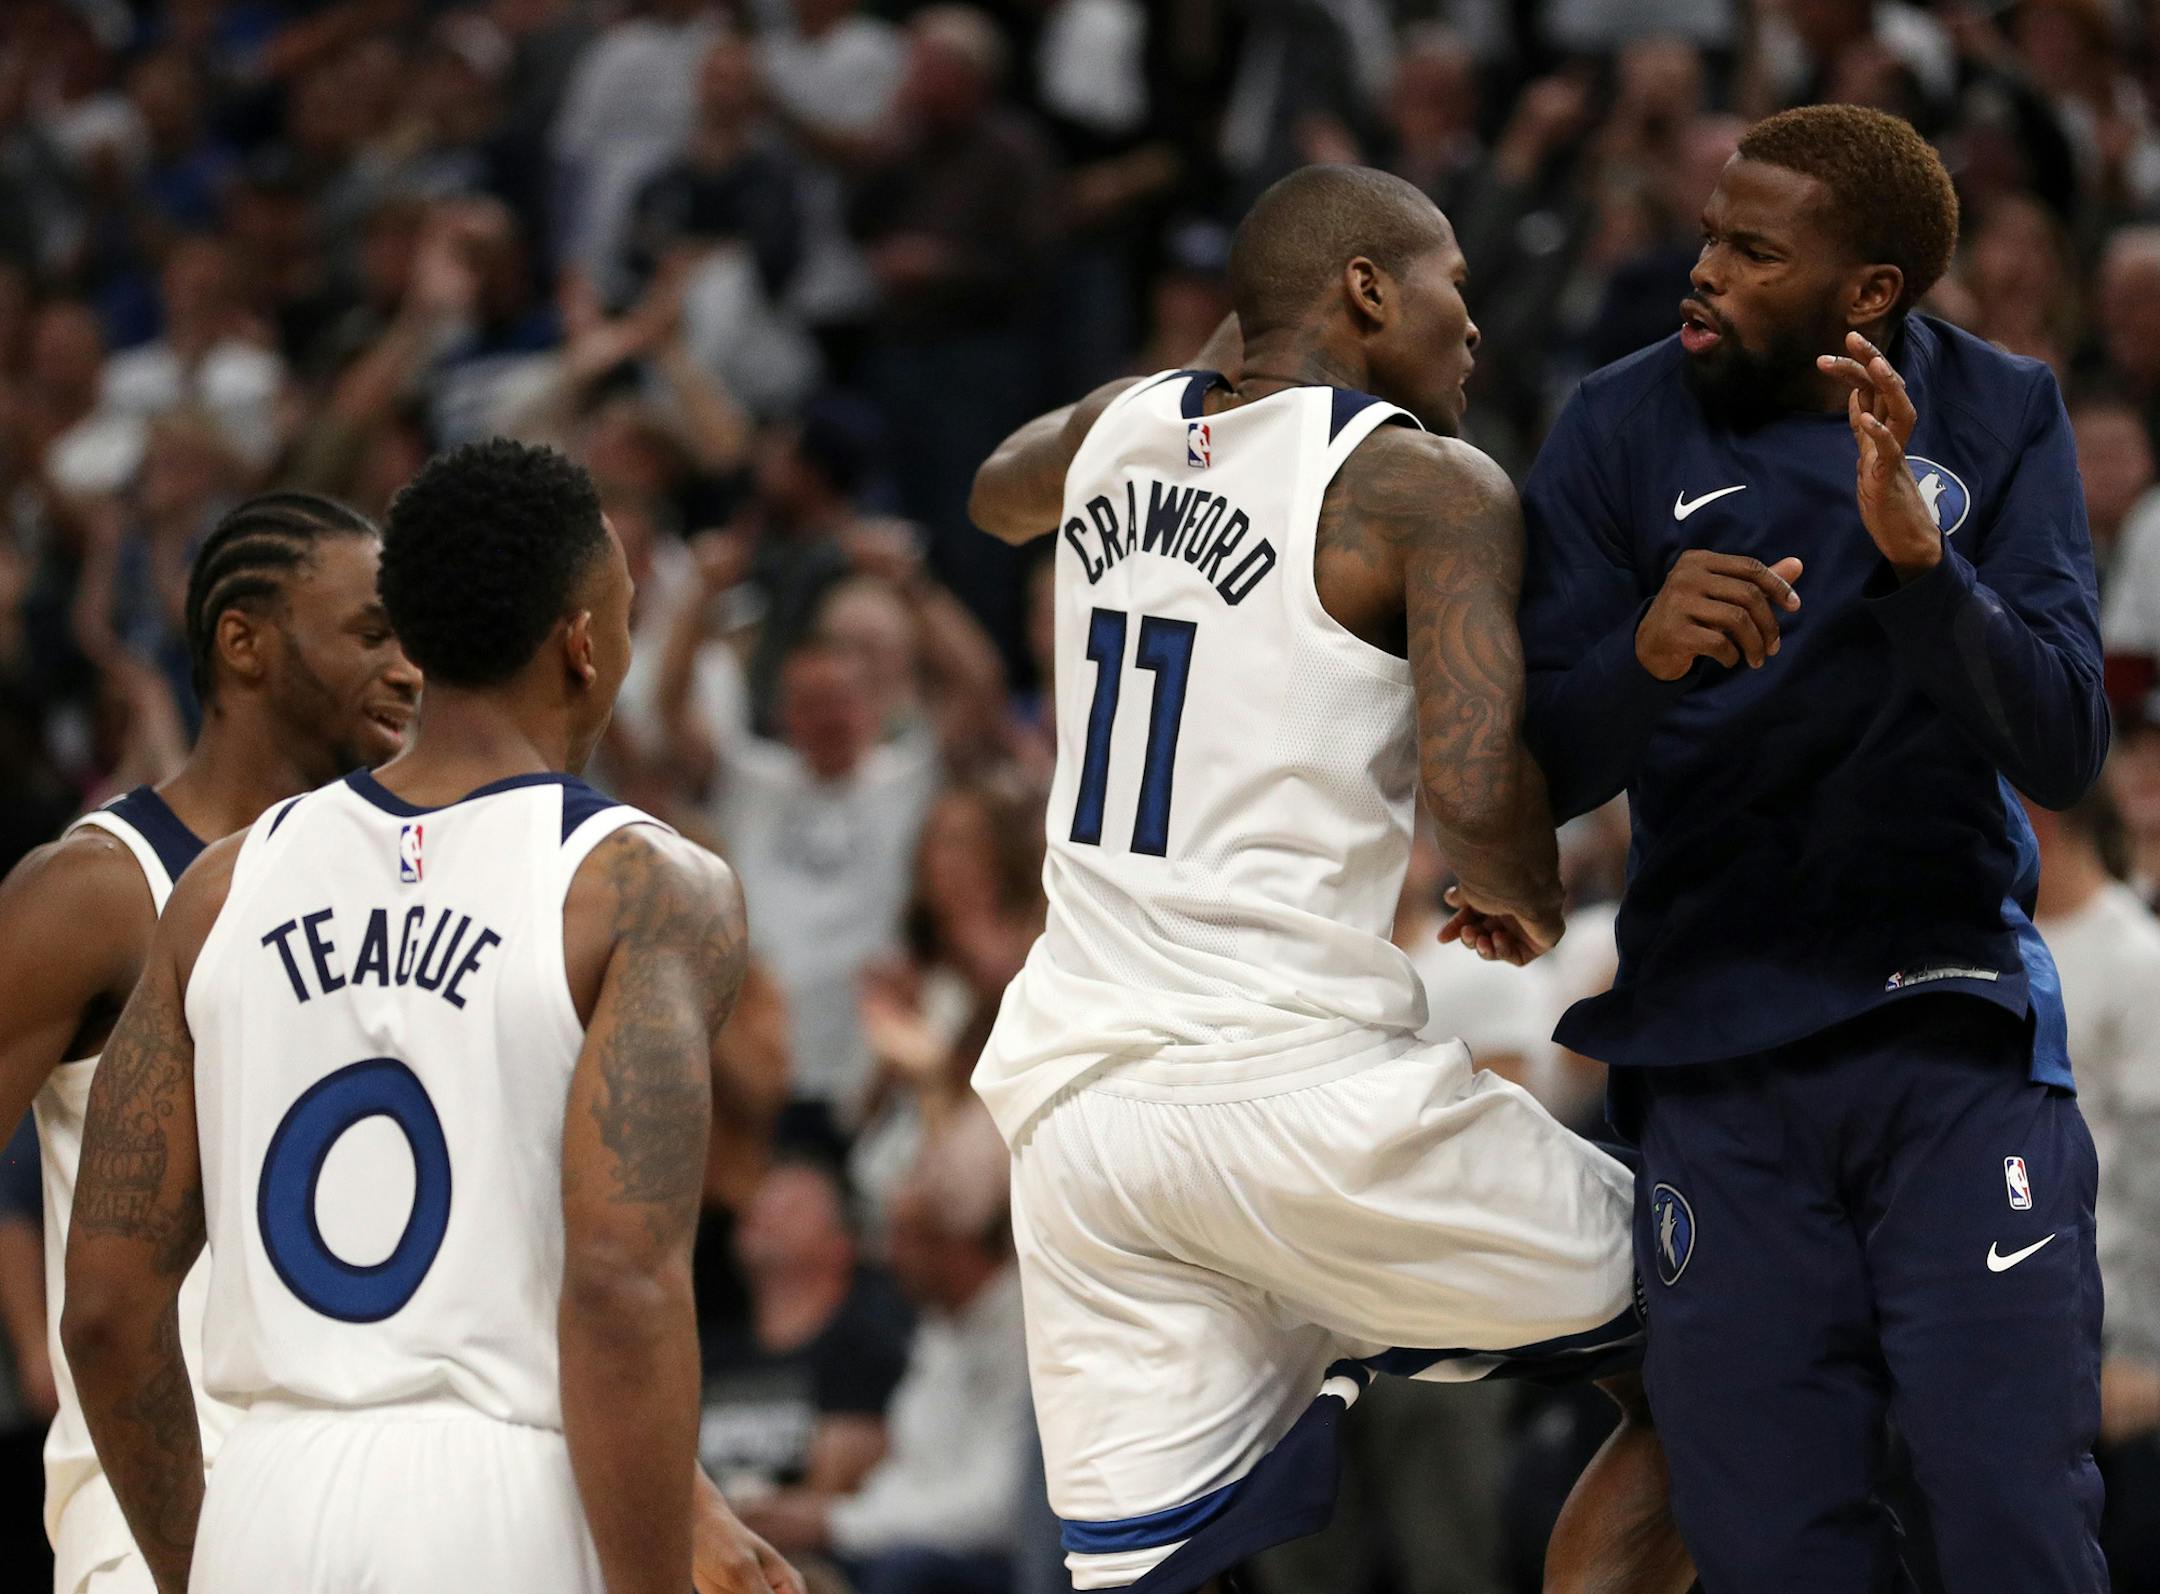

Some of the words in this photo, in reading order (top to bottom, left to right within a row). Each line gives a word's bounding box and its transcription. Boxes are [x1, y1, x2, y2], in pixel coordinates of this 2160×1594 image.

[1065, 480, 1276, 606] CRAWFORD
[1069, 607, 1198, 858] 11
[261, 905, 502, 1010] TEAGUE
[257, 1056, 452, 1324] 0
